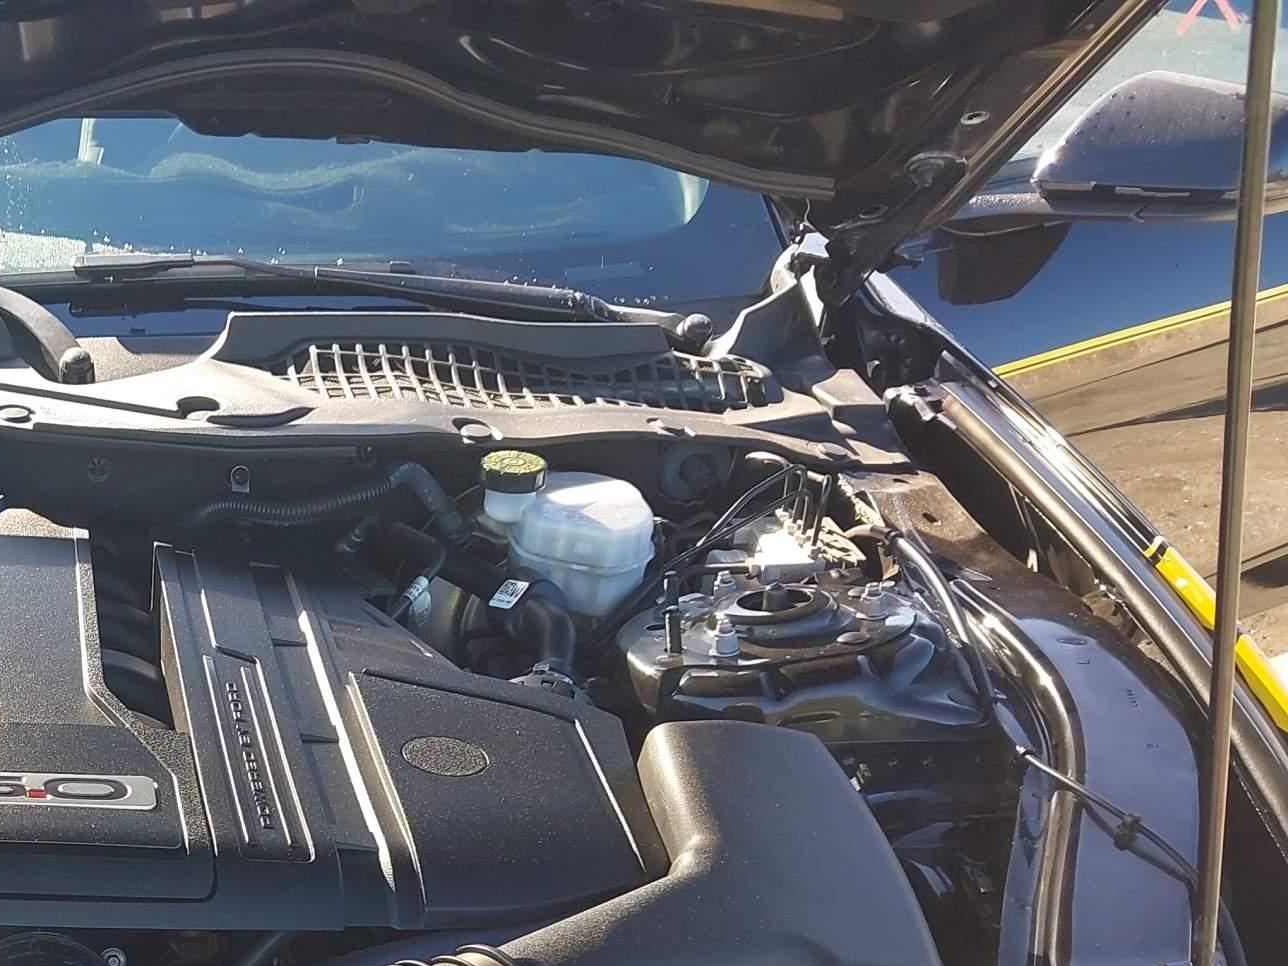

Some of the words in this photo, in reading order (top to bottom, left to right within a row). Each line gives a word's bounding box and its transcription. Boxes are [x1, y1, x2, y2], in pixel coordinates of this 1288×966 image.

[225, 682, 247, 723] FORD
[235, 724, 252, 748] BY
[242, 750, 274, 829] POWERED
